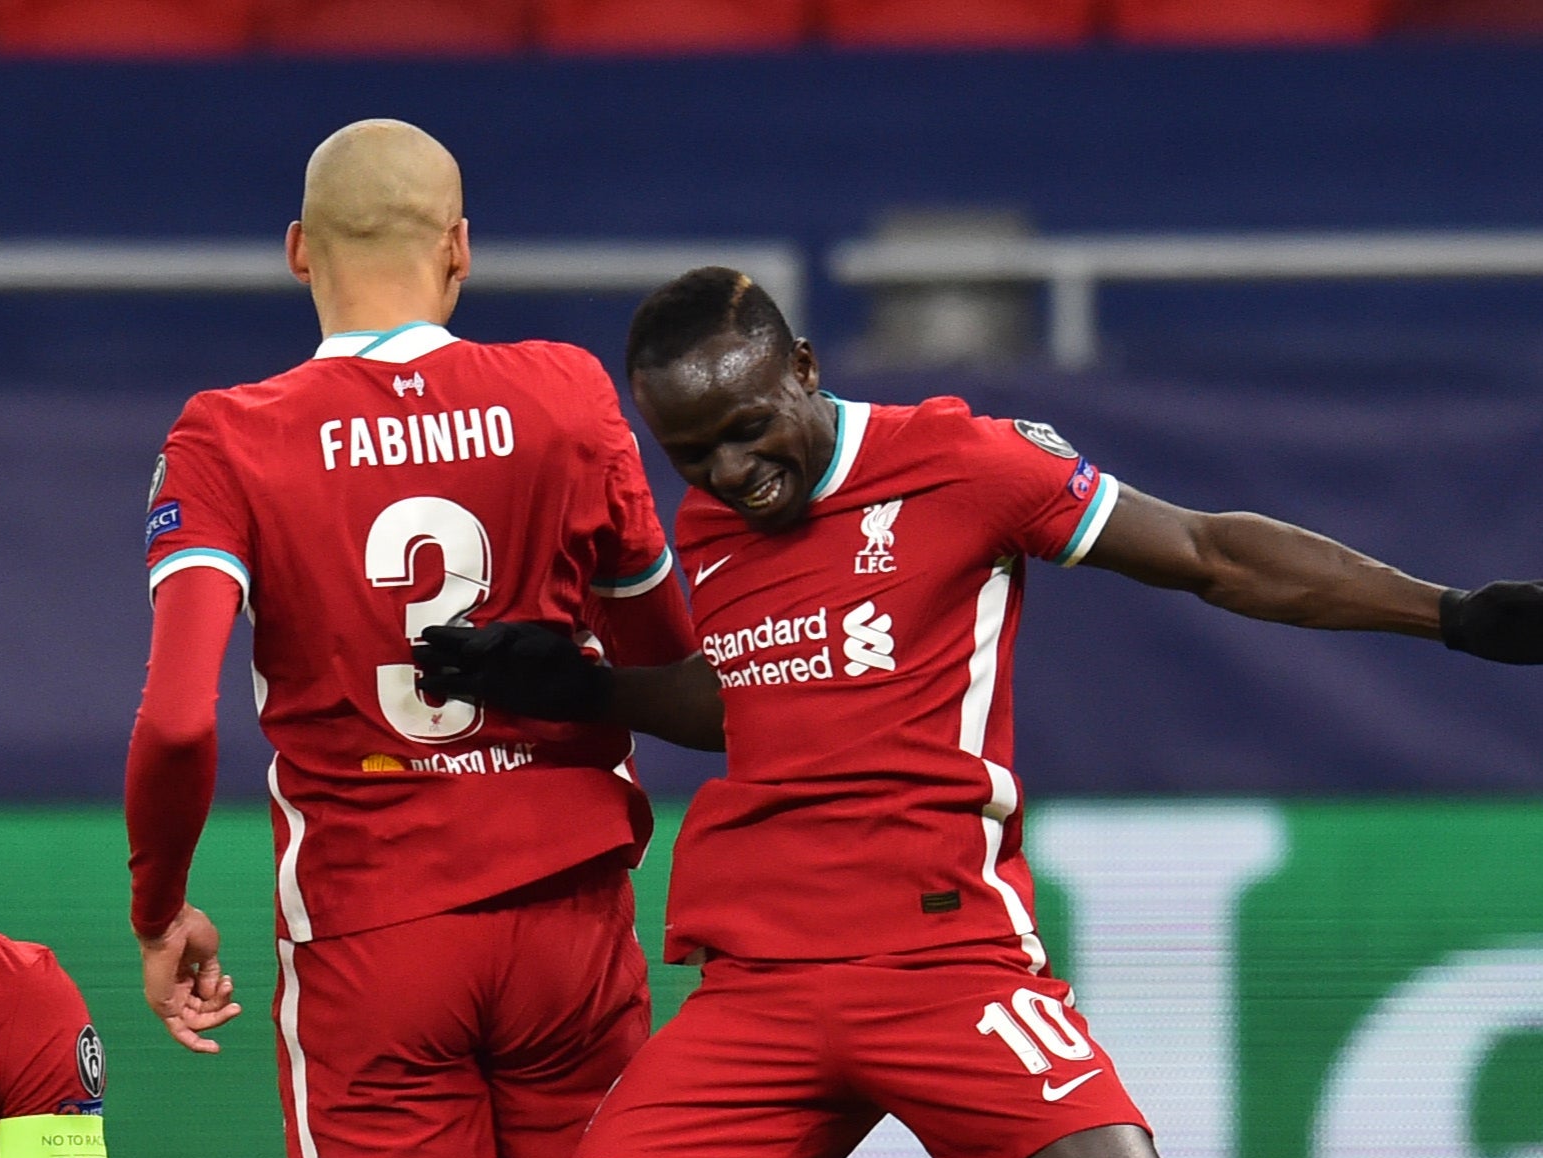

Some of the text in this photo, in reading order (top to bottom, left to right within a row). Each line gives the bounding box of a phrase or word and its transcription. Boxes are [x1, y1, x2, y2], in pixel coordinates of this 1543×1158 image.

[320, 406, 514, 470] FABINHO
[365, 496, 492, 744] 3
[703, 607, 827, 666] Standard
[716, 646, 833, 688] hartered
[975, 988, 1094, 1075] 10
[41, 1135, 64, 1146] NO
[67, 1135, 84, 1146] TO
